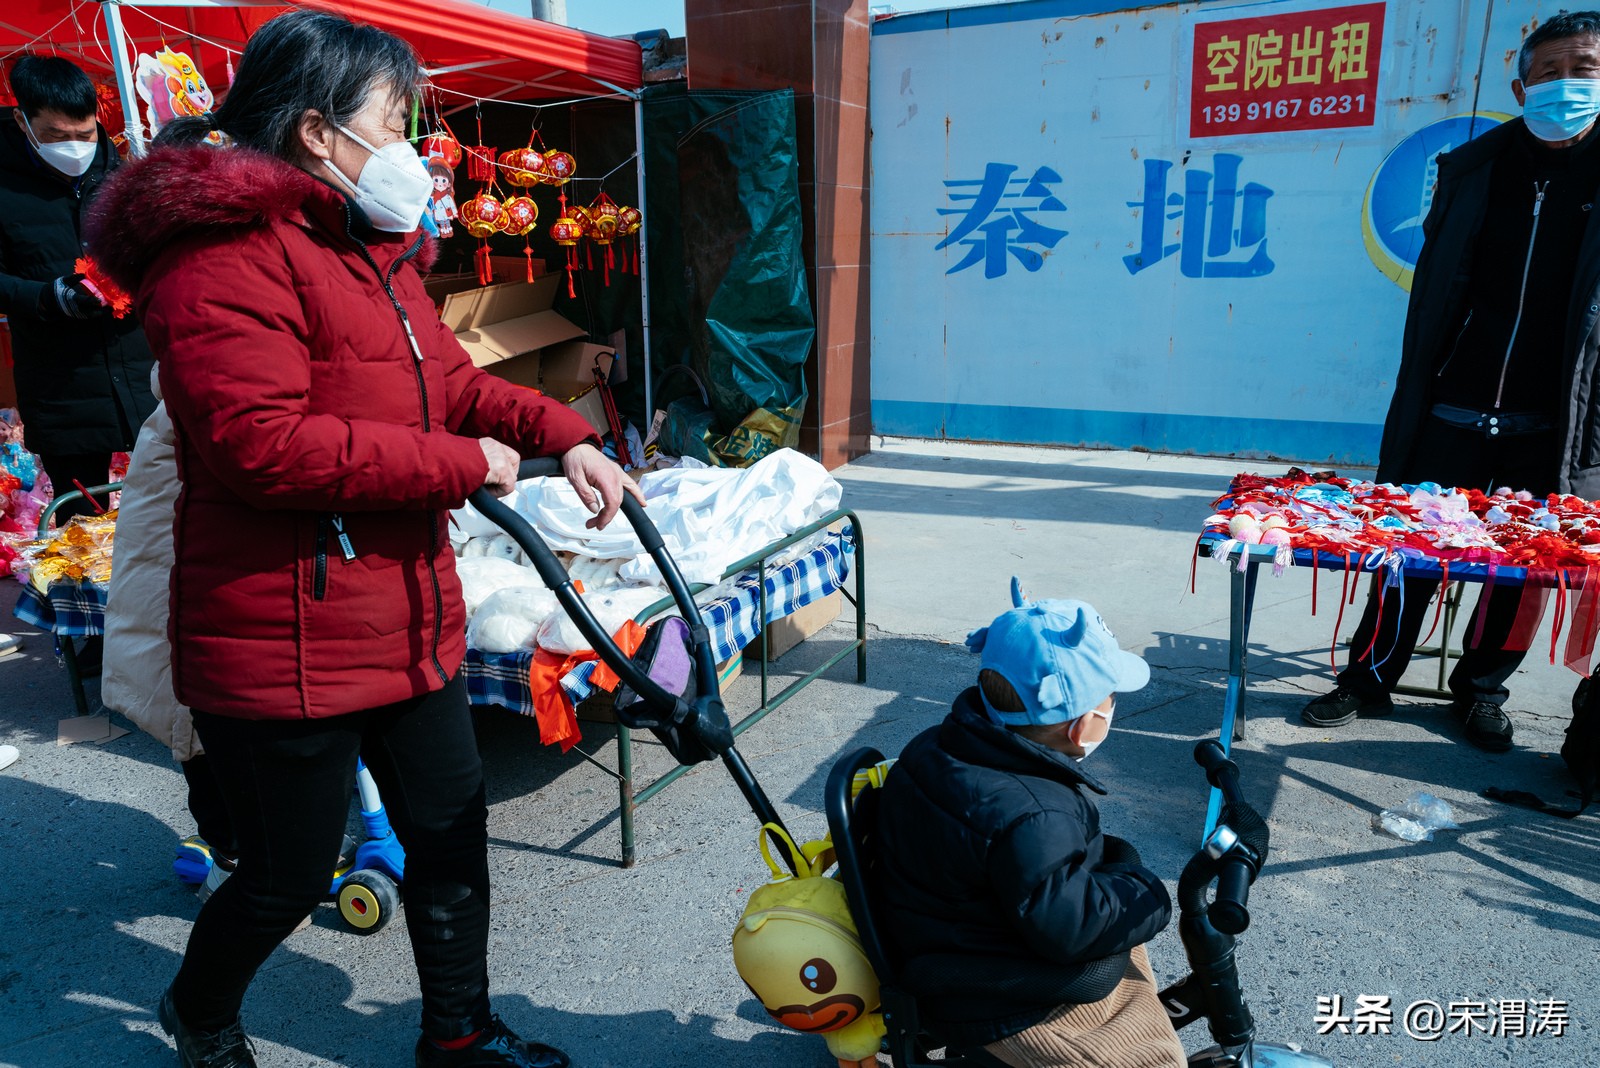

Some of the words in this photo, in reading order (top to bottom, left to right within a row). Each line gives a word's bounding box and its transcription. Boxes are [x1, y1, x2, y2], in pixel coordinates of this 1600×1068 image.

[1205, 21, 1370, 92] 空院出租
[1202, 103, 1241, 124] 139
[1246, 99, 1302, 121] 9167
[1309, 94, 1367, 116] 6231
[934, 153, 1275, 280] 秦地
